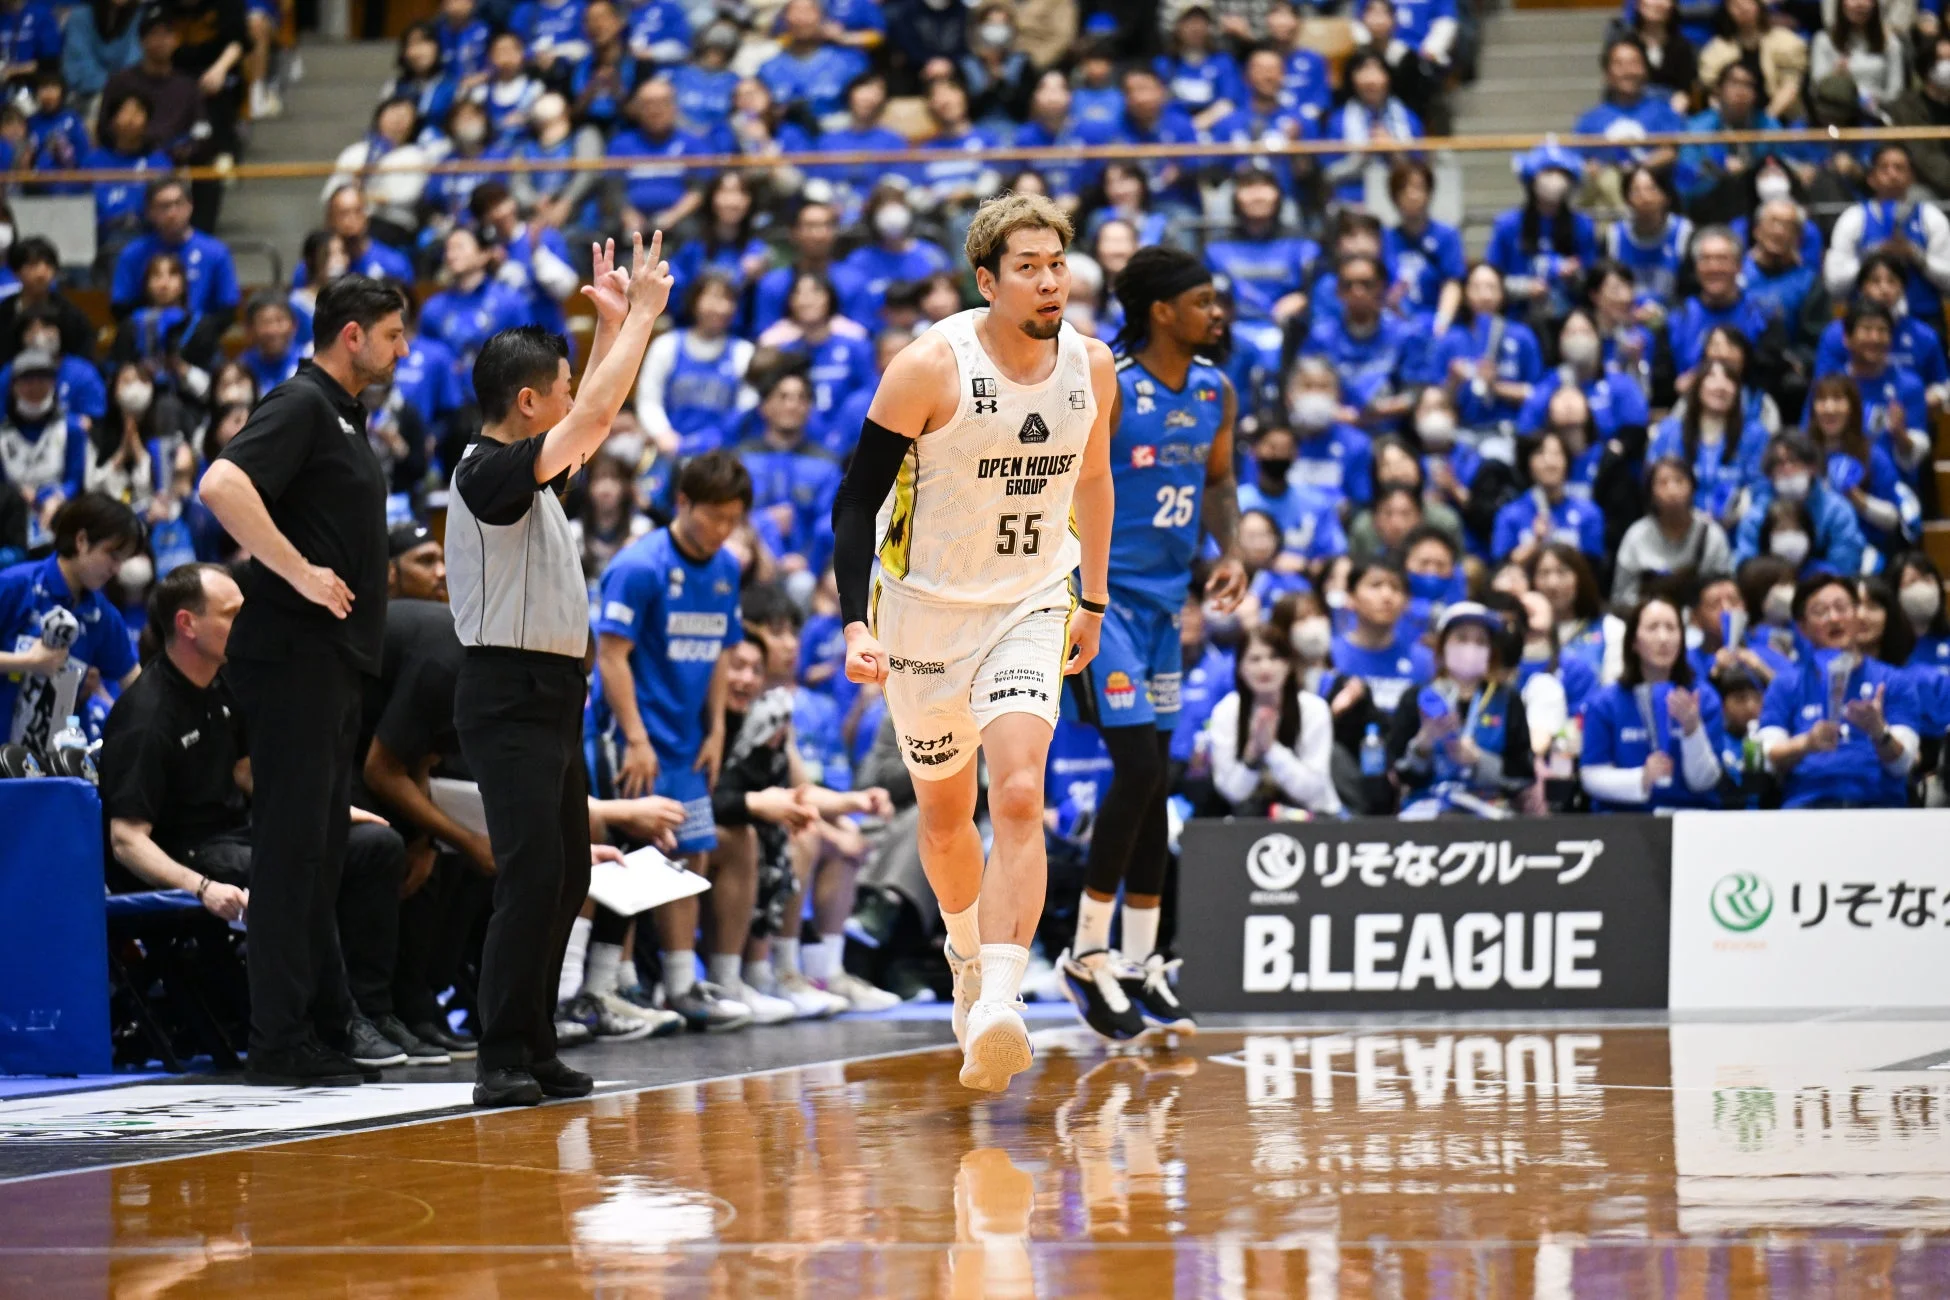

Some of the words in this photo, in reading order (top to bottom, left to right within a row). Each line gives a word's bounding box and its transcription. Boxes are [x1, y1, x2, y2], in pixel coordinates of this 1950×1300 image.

[978, 457, 1024, 479] OPEN
[1025, 454, 1077, 476] HOUSE
[1006, 479, 1048, 496] GROUP
[1153, 485, 1197, 529] 25
[995, 511, 1045, 556] 55
[903, 658, 945, 668] RYOMO
[912, 666, 946, 675] SYSTEMS
[1017, 668, 1045, 678] HOUSE
[1313, 838, 1604, 888] りそなグループ
[1791, 881, 1950, 929] りそな
[1243, 911, 1604, 992] B.LEAGUE
